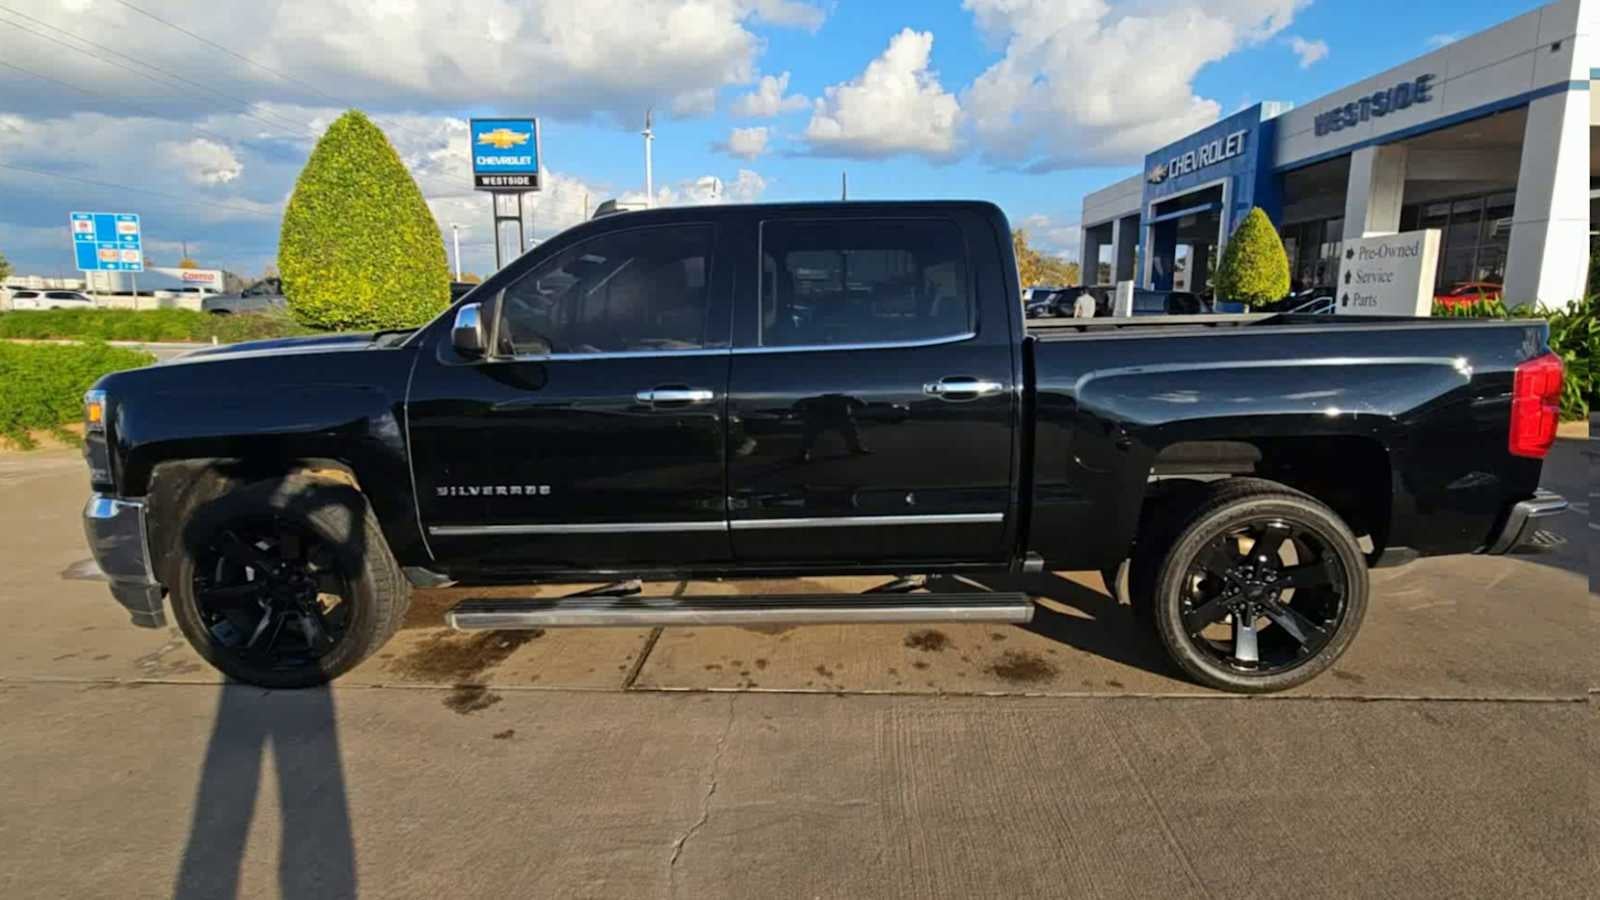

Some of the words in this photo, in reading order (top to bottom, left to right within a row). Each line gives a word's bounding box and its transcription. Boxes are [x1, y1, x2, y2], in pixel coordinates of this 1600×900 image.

[1314, 73, 1436, 138] WESTSIDE
[476, 156, 532, 166] CHEVROLET
[1168, 129, 1249, 178] CHEVROLET
[481, 176, 530, 185] WESTSIDE
[1359, 240, 1419, 261] Pre-Owned
[1355, 269, 1394, 284] Service
[1352, 292, 1377, 307] Parts
[436, 485, 551, 496] SILVERADO
